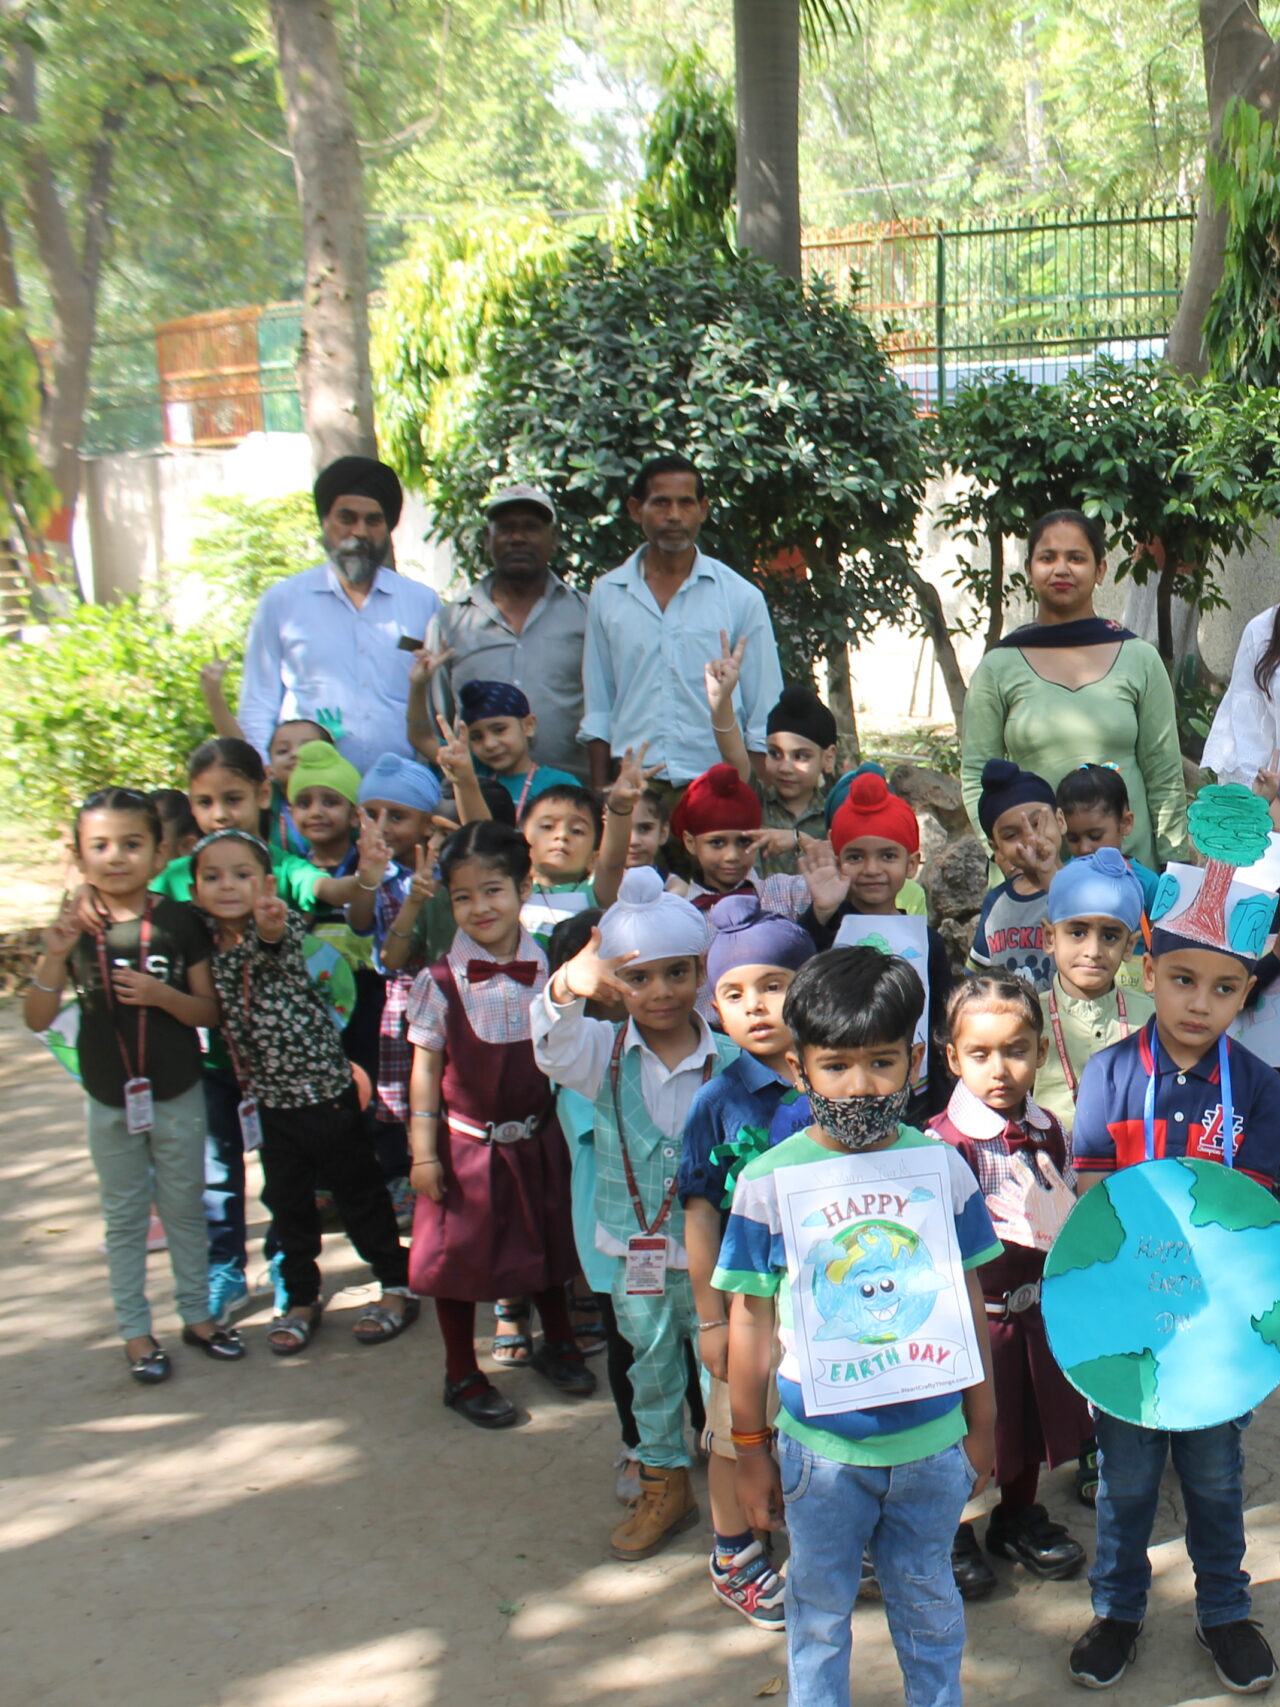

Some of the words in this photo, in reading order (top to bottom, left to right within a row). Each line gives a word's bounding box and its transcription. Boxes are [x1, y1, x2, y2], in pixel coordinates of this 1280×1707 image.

[987, 926, 1044, 954] MICKE
[821, 1193, 910, 1228] HAPPY
[830, 1347, 900, 1382] EARTH
[908, 1342, 951, 1364] DAY
